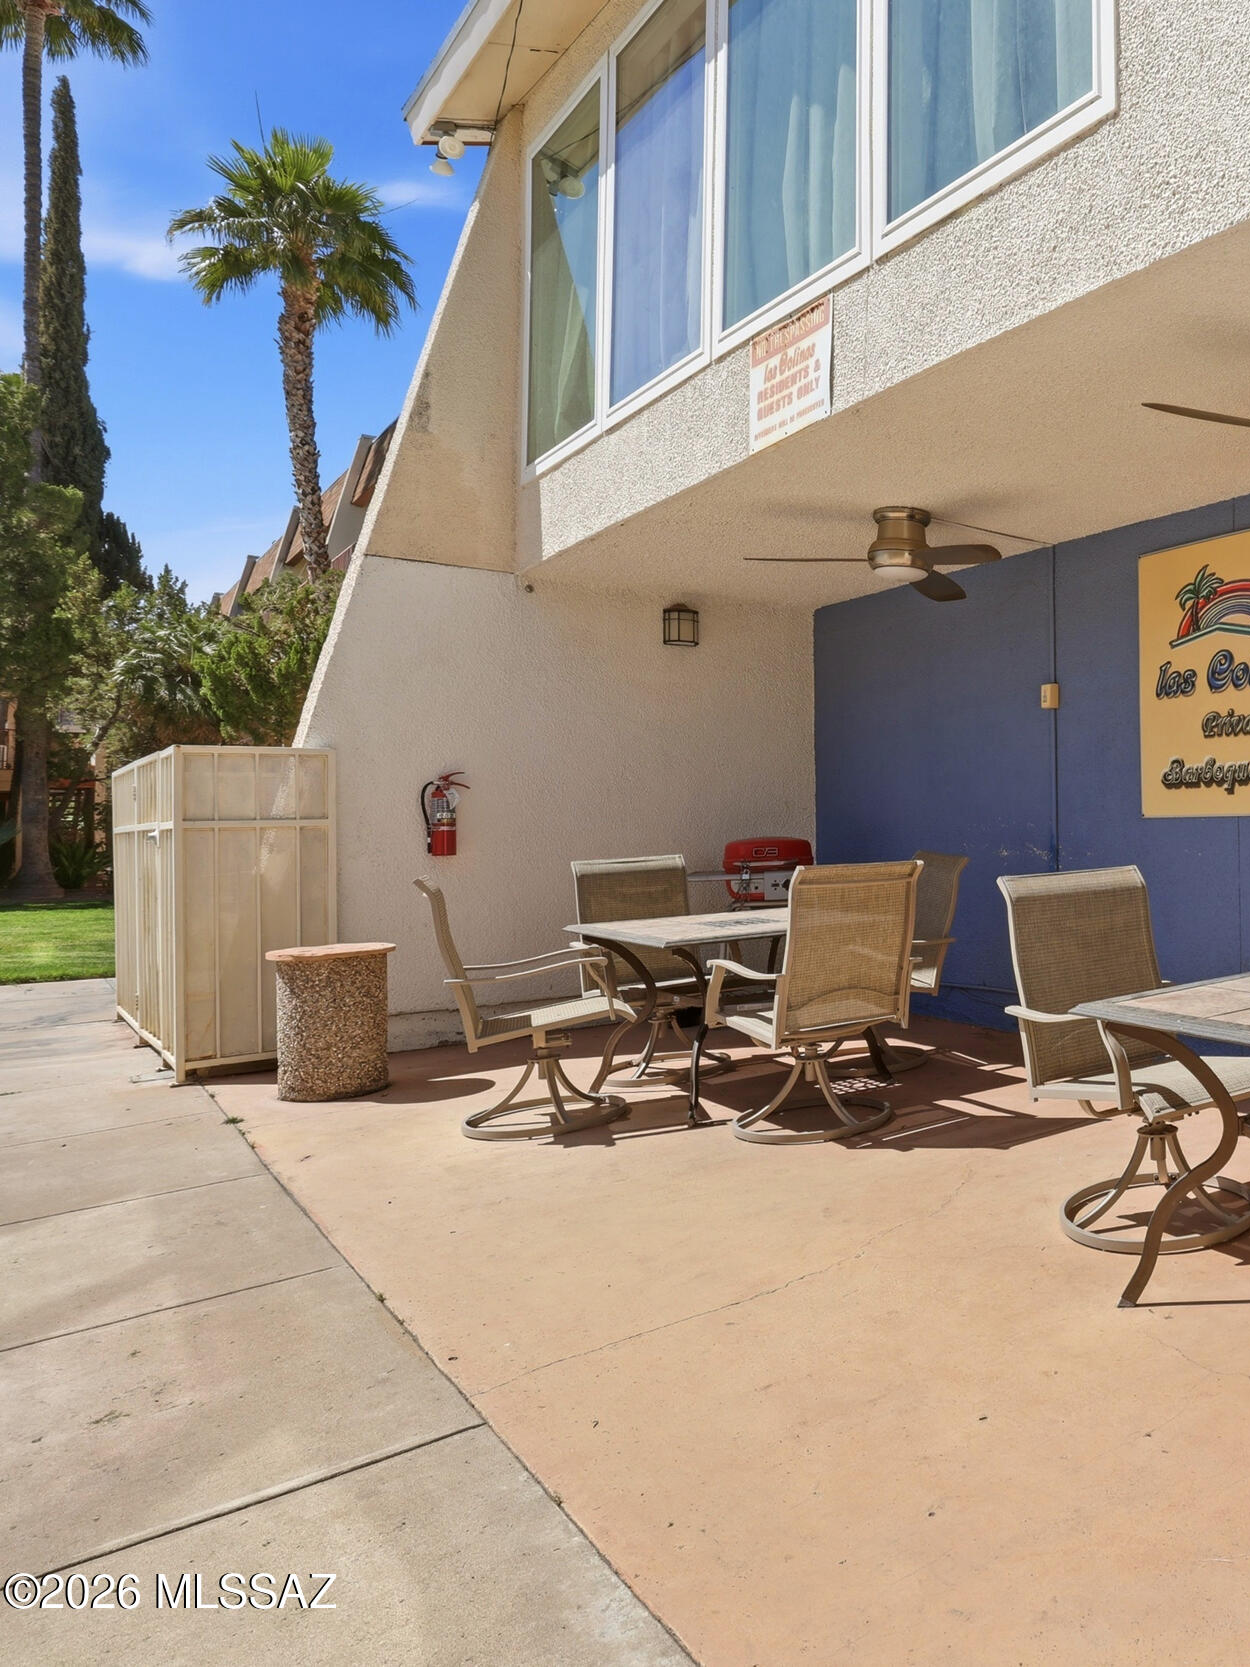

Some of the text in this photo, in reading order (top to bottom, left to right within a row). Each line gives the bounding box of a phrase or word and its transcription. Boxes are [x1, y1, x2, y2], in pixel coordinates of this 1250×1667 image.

[779, 342, 816, 376] Colinas
[757, 364, 810, 405] RESIDENTS
[757, 391, 793, 421] GUESTS
[797, 375, 821, 400] ONLY
